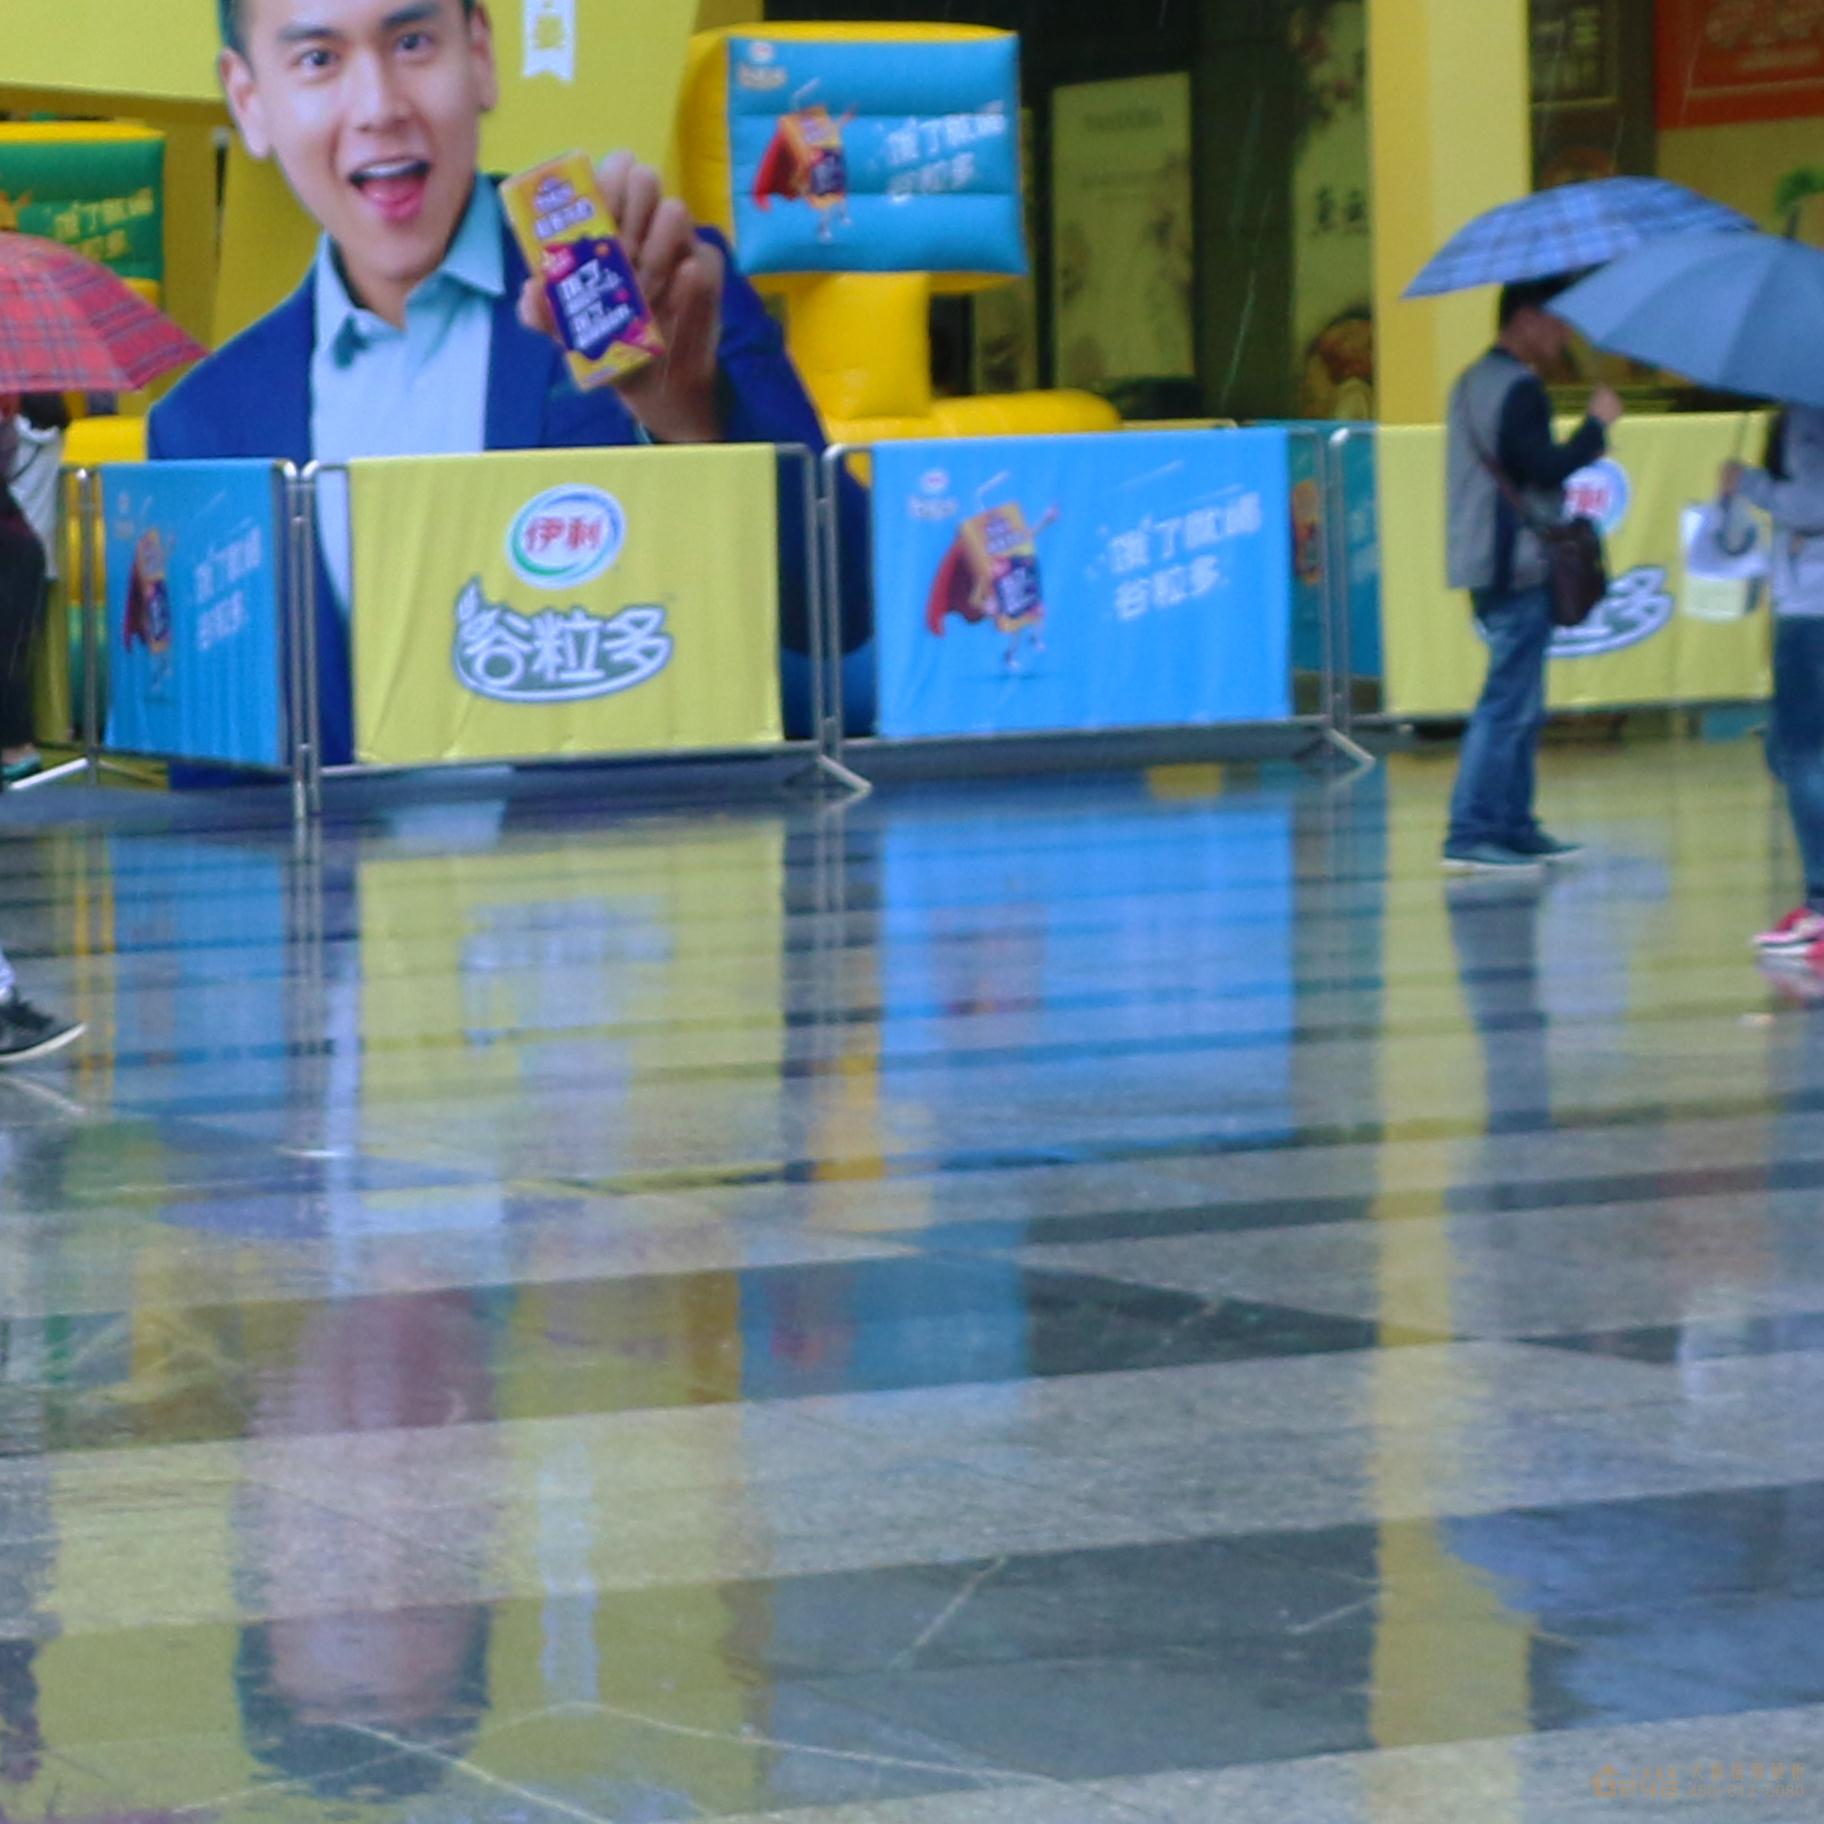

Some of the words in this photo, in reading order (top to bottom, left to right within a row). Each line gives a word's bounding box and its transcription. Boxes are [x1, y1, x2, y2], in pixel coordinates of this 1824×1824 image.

[524, 516, 603, 553] 伊利
[455, 593, 670, 697] 谷粒多
